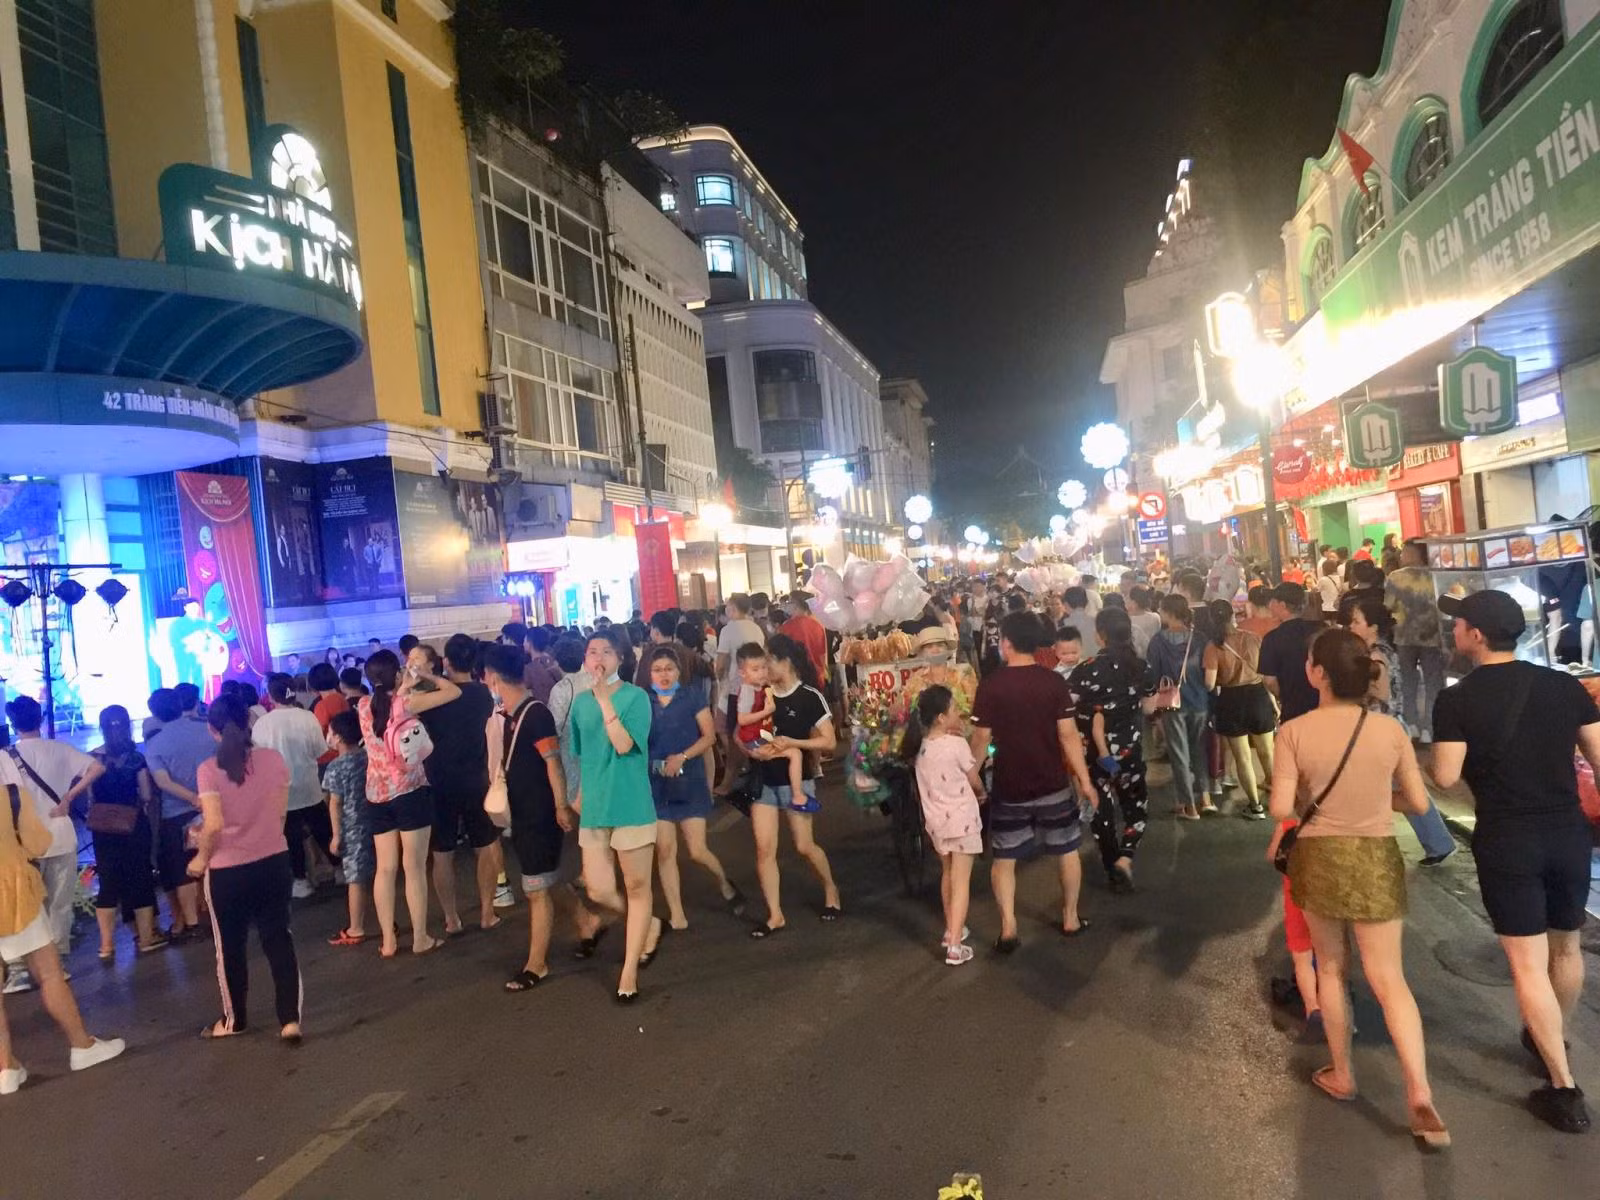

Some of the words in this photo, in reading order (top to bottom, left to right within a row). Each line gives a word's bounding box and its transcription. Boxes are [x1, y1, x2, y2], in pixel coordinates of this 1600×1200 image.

[1426, 216, 1464, 275] KEM
[1471, 238, 1515, 281] SINCE
[1514, 211, 1550, 259] 1958
[102, 391, 122, 410] 42
